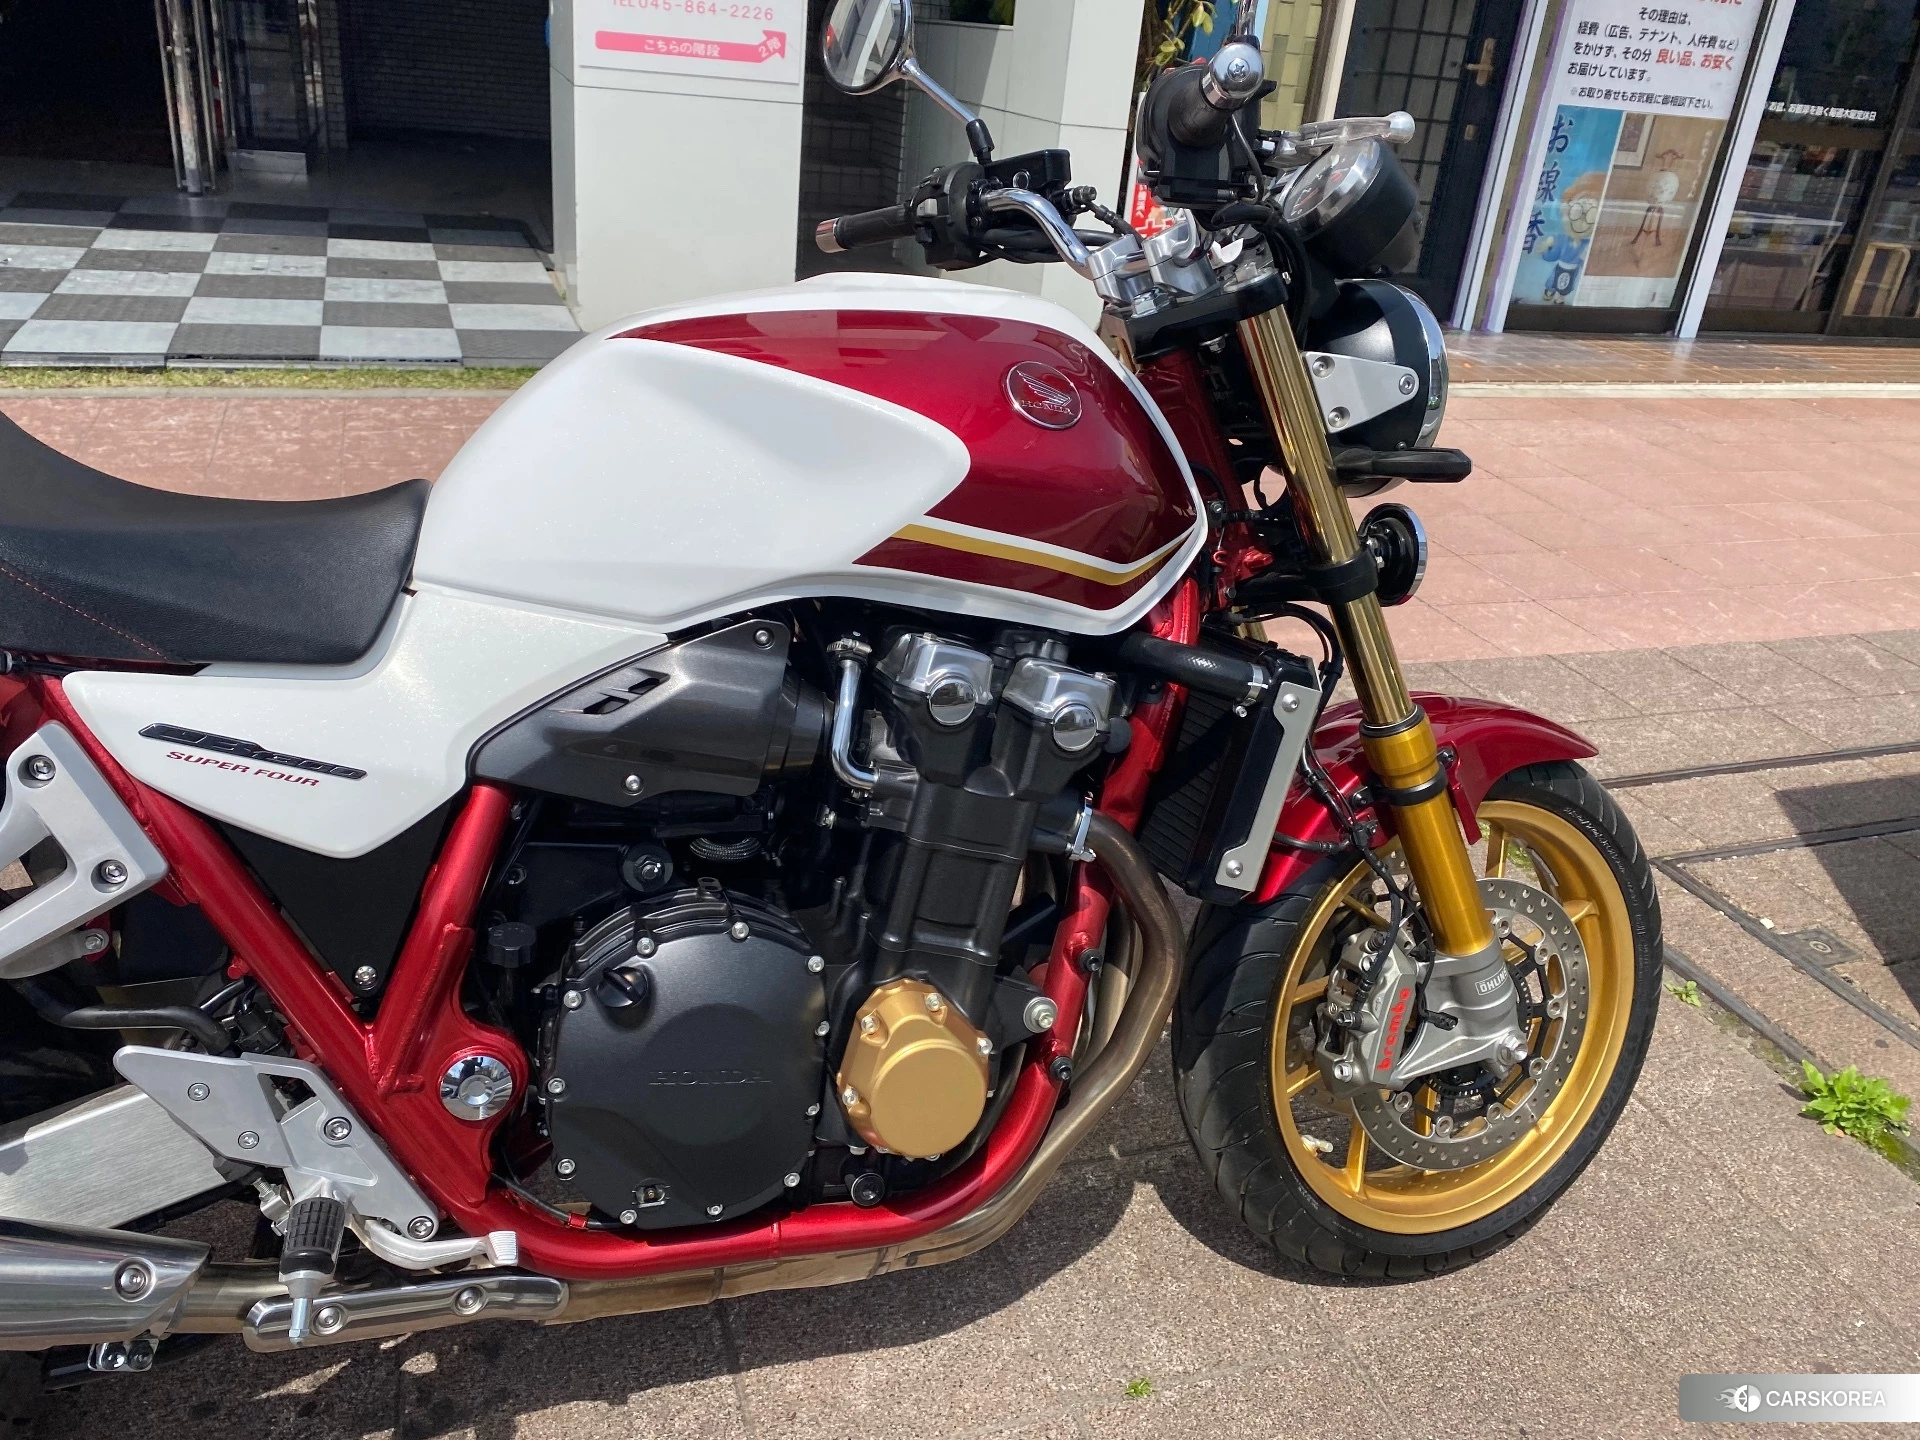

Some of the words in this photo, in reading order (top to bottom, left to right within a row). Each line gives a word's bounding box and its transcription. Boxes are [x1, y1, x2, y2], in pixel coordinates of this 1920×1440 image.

[1639, 7, 1692, 25] その理由は、
[644, 39, 721, 57] こちらの階段
[758, 36, 782, 58] 2階
[1567, 61, 1651, 82] お届けしています。
[1021, 399, 1075, 416] HONDA
[166, 751, 251, 773] SUPER
[253, 768, 320, 788] FOUR
[1376, 988, 1411, 1071] brembo
[648, 1070, 771, 1085] HONDA
